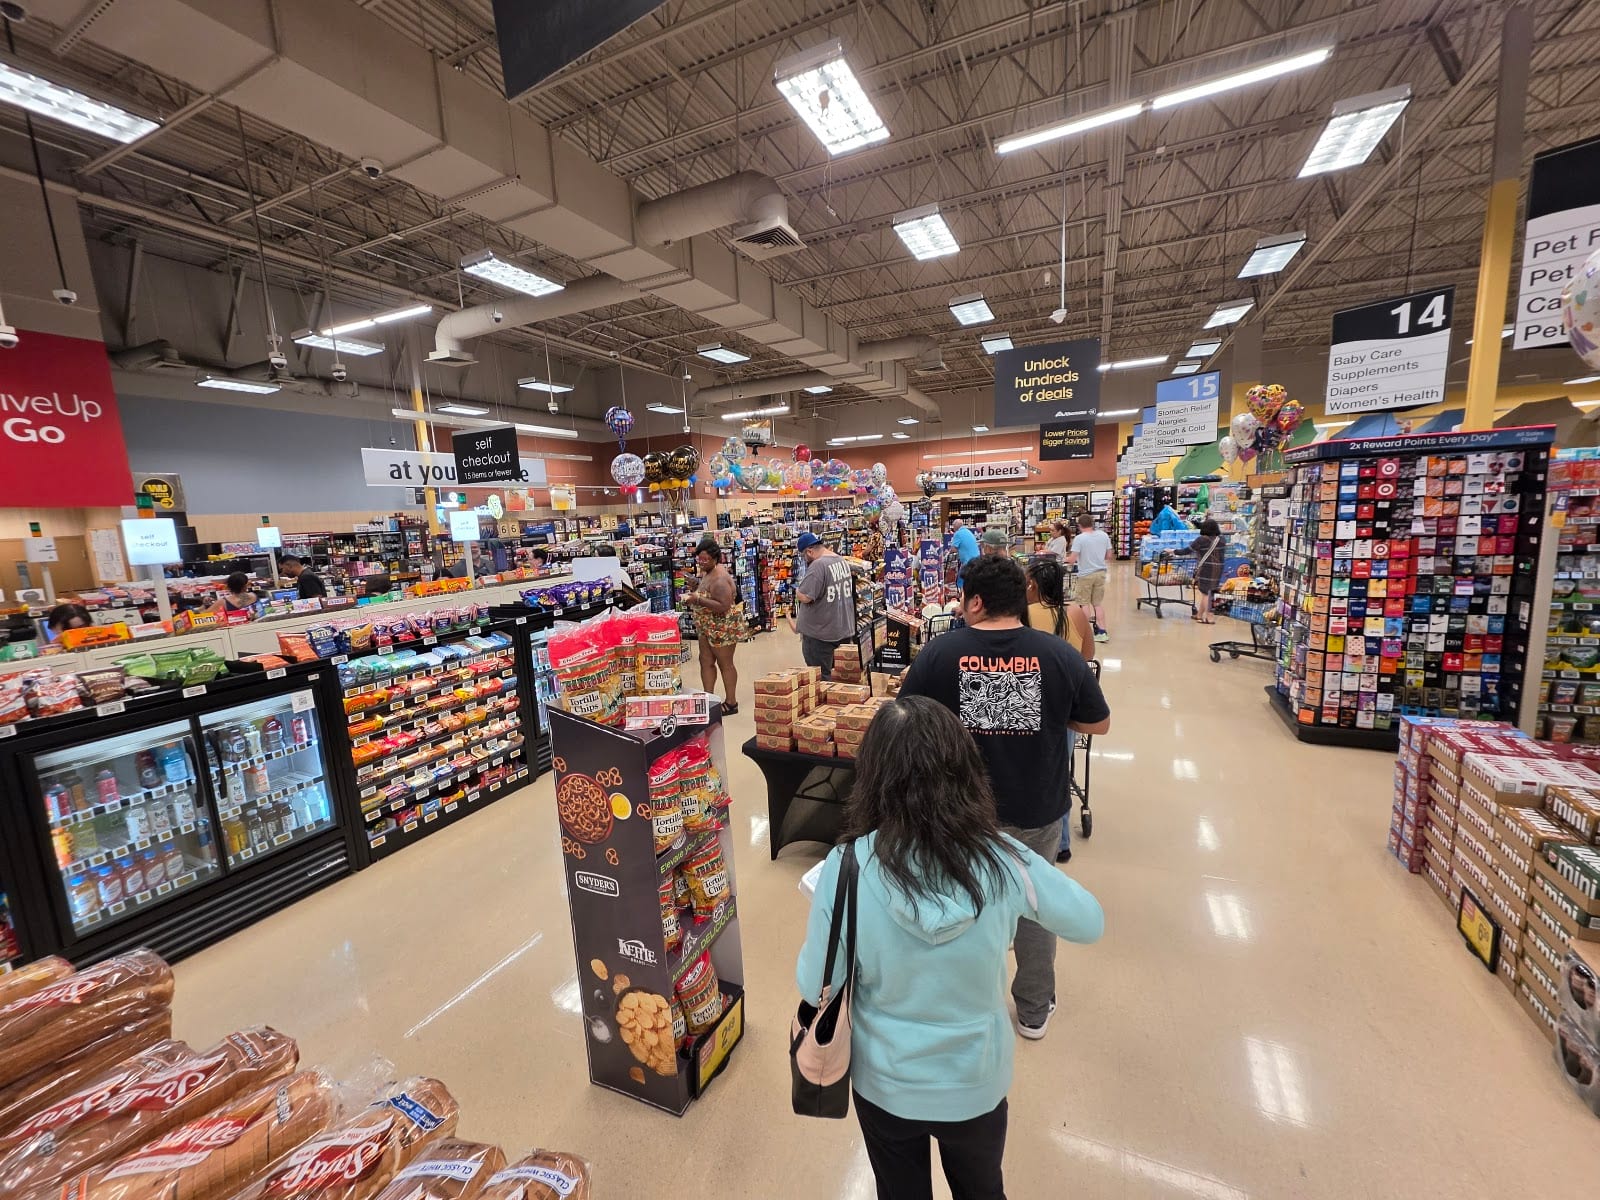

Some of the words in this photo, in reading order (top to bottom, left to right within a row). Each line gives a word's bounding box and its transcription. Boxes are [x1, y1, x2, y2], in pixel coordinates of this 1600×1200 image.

[1532, 235, 1578, 259] Pet
[1530, 265, 1574, 287] Pet
[1390, 294, 1447, 335] 14
[1526, 297, 1562, 314] Ca
[1024, 355, 1071, 373] Unlock
[1333, 353, 1367, 368] Baby
[1370, 349, 1402, 361] Care
[1014, 370, 1080, 390] hundreds
[1331, 360, 1419, 382] Supplements
[1019, 387, 1034, 402] of
[1036, 385, 1073, 402] deals
[1187, 376, 1218, 399] 15
[1330, 382, 1379, 398] Diapers
[0, 391, 103, 422] iveUp
[1157, 407, 1189, 417] Stomach
[1190, 403, 1212, 412] Relief
[1329, 395, 1390, 412] Women's
[1393, 388, 1440, 404] Health
[2, 416, 66, 444] Go
[1156, 427, 1180, 438] Cough
[1188, 424, 1206, 432] Cold
[1157, 417, 1187, 426] Allergies
[474, 436, 493, 451] self
[1042, 438, 1064, 447] Bigger
[1064, 437, 1091, 446] Savings
[1045, 430, 1067, 438] Lower
[1067, 429, 1089, 437] Prices
[1156, 437, 1185, 447] Shaving
[1349, 441, 1361, 450] 2x
[1362, 438, 1403, 450] Reward
[1404, 436, 1438, 447] Points
[1438, 434, 1468, 447] Every
[461, 450, 511, 468] checkout
[389, 460, 413, 481] at
[418, 463, 458, 486] you
[464, 472, 472, 480] 15
[472, 469, 487, 480] items
[495, 468, 513, 478] fewer
[939, 466, 970, 479] world
[973, 465, 985, 477] of
[987, 465, 1020, 477] beers
[828, 559, 852, 582] WAL
[958, 655, 1041, 673] COLUMBIA
[646, 670, 671, 681] Tortilla
[648, 679, 670, 689] Chips
[568, 692, 600, 707] Tortilla
[573, 702, 599, 714] Chips
[1435, 738, 1458, 762] mini
[1437, 759, 1458, 784] mini
[1470, 761, 1498, 788] mini
[681, 797, 698, 808] tilla
[1435, 782, 1457, 806] mini
[655, 812, 682, 827] Tortilla
[682, 806, 696, 816] ips
[1434, 803, 1455, 829] mini
[1553, 796, 1588, 834] mini
[657, 823, 682, 835] Chips
[1431, 826, 1452, 851] mini
[1504, 816, 1534, 848] mini
[660, 849, 684, 875] Elevate
[1431, 846, 1450, 872] mini
[1500, 841, 1530, 875] mini
[578, 874, 616, 892] SNYDER'S
[704, 872, 726, 889] Tortilla
[1428, 870, 1448, 896] mini
[1497, 867, 1527, 901] mini
[1557, 857, 1599, 901] mini
[1493, 891, 1521, 927] mini
[1543, 879, 1580, 921] mini
[662, 917, 675, 929] tilla
[663, 928, 676, 938] ips
[616, 937, 658, 964] KETTLE
[672, 949, 700, 983] Amazing
[700, 903, 736, 951] DELICIOUS!
[1501, 926, 1518, 953] ini
[1535, 935, 1562, 970] min
[1500, 954, 1516, 980] ini
[1531, 964, 1559, 1000] min
[1529, 993, 1557, 1030] min
[310, 1141, 379, 1180] Sara
[440, 1163, 473, 1176] CLASSIC
[539, 1170, 570, 1191] CLASSIC
